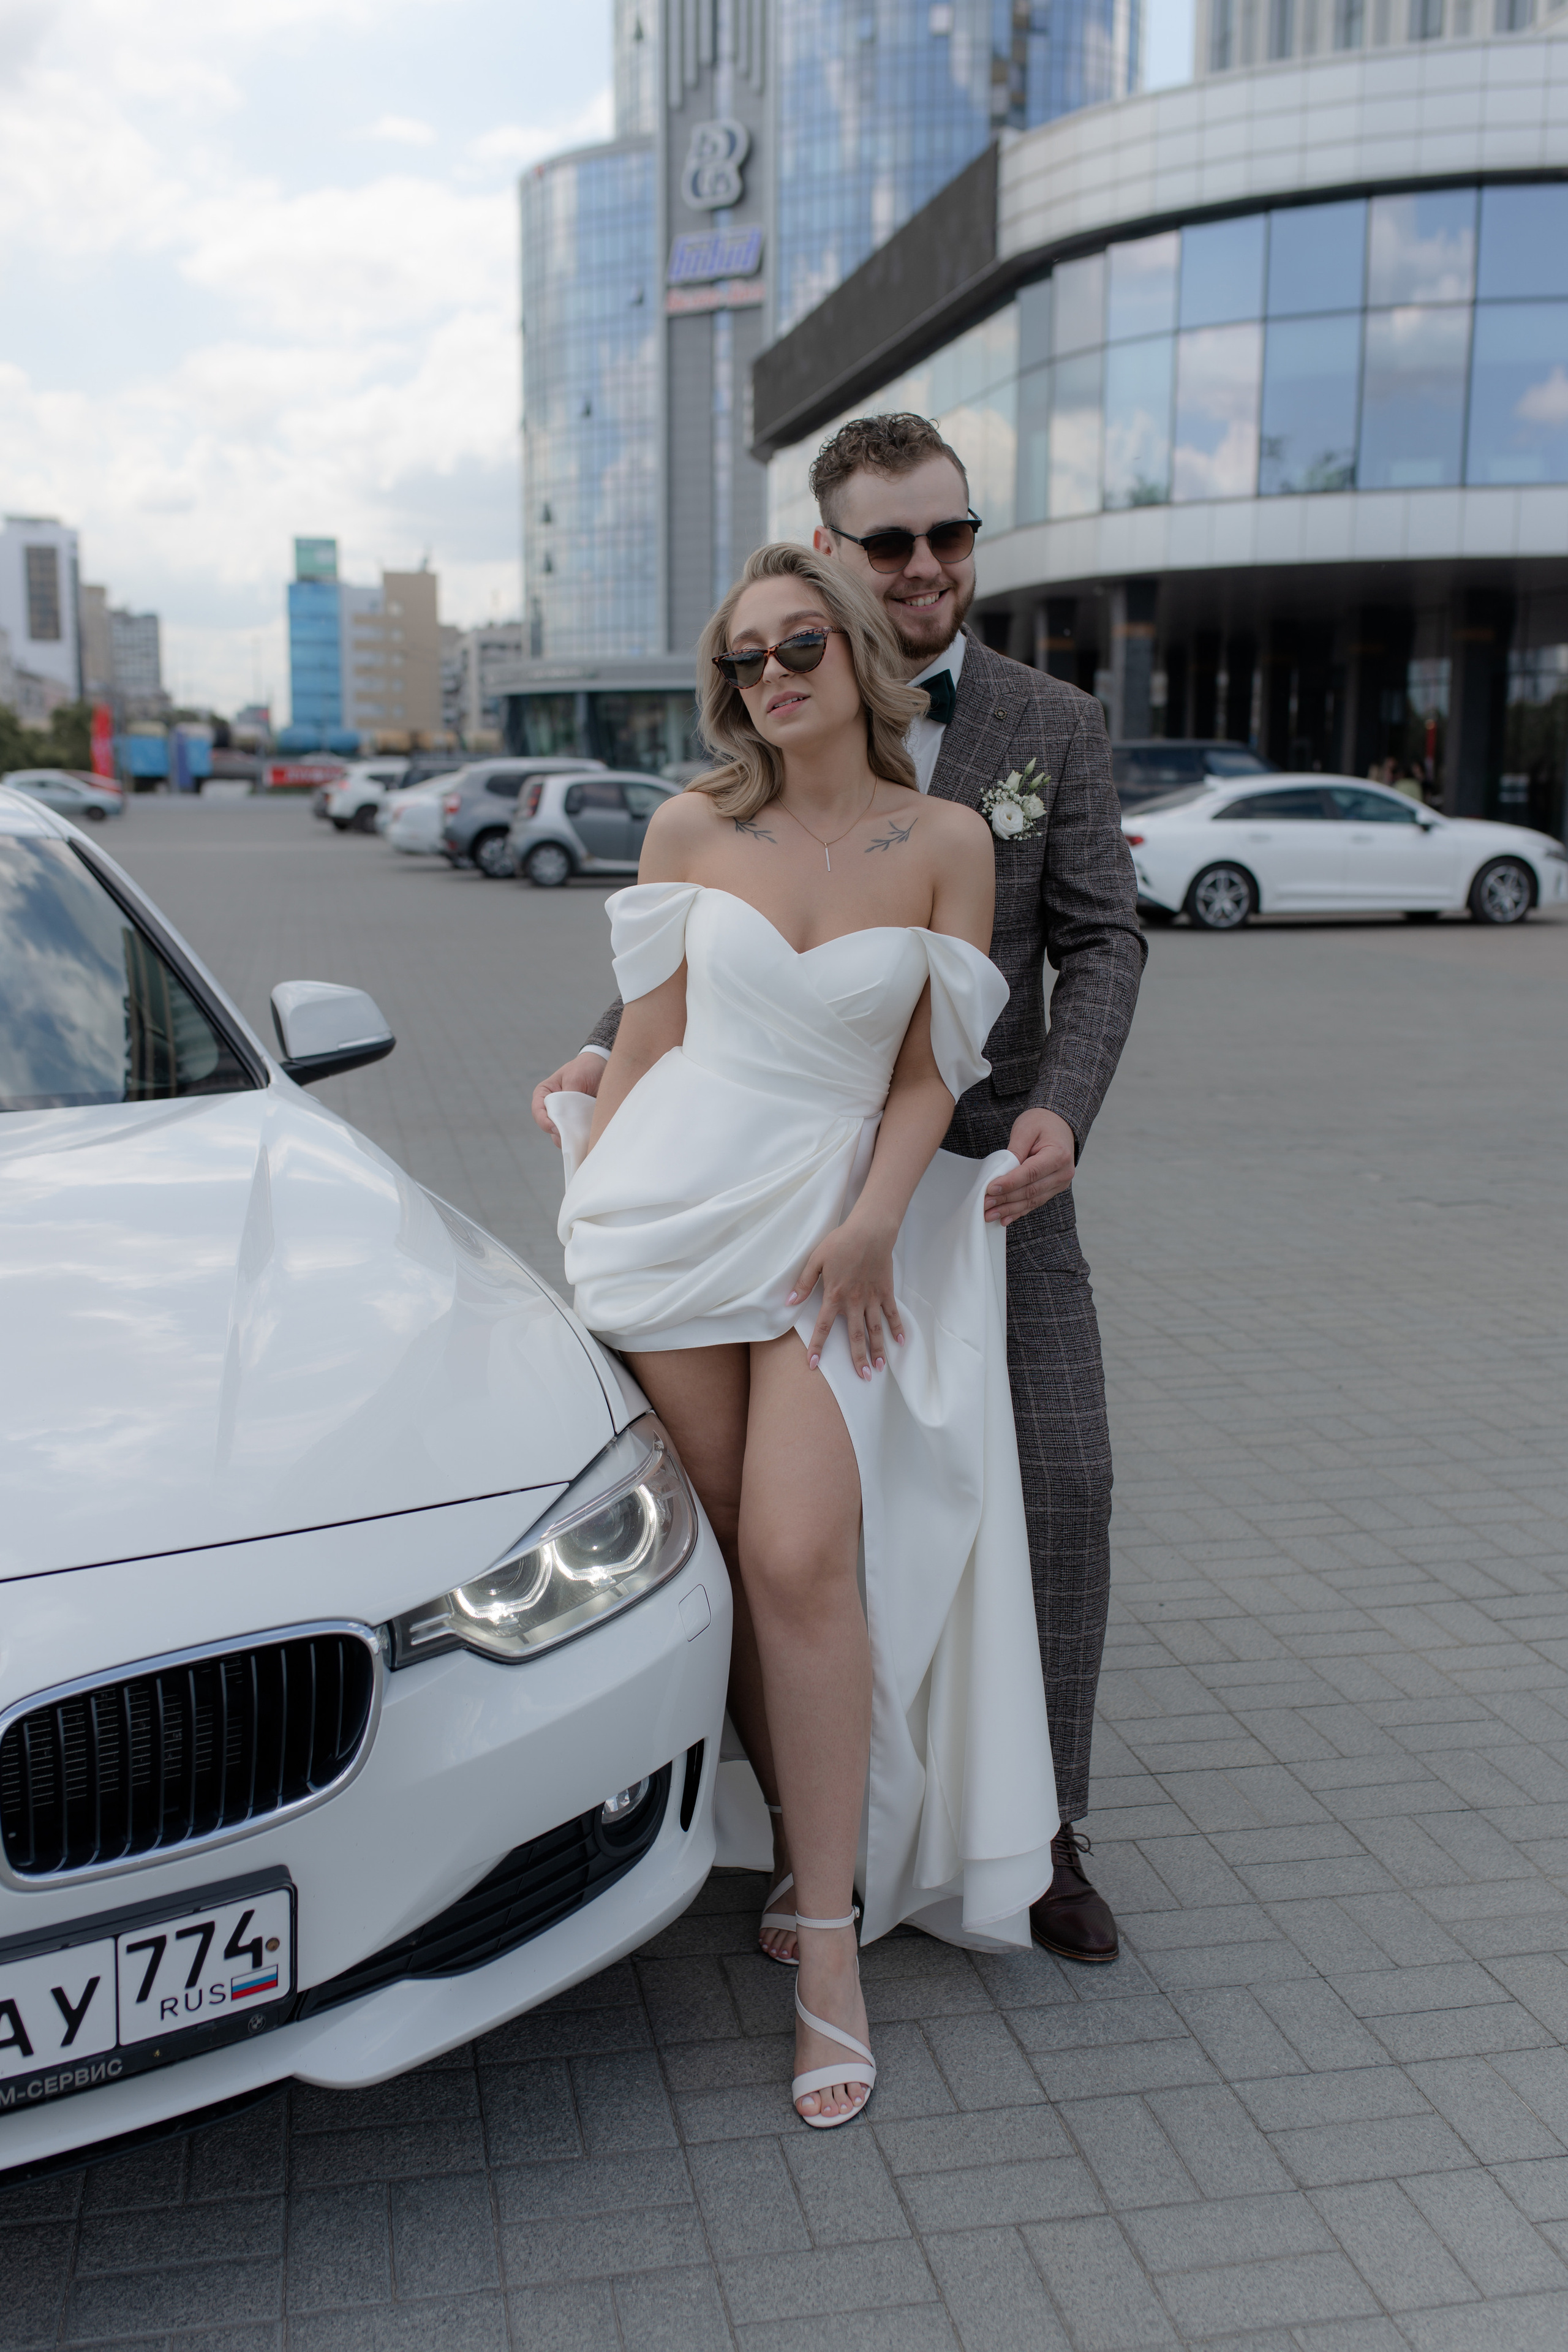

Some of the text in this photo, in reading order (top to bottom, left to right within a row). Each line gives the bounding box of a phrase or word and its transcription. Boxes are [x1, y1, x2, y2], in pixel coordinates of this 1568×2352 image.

[126, 1909, 263, 2004] 774
[160, 1983, 227, 2021] RUS
[0, 2057, 123, 2106] М-СЕРВИС
